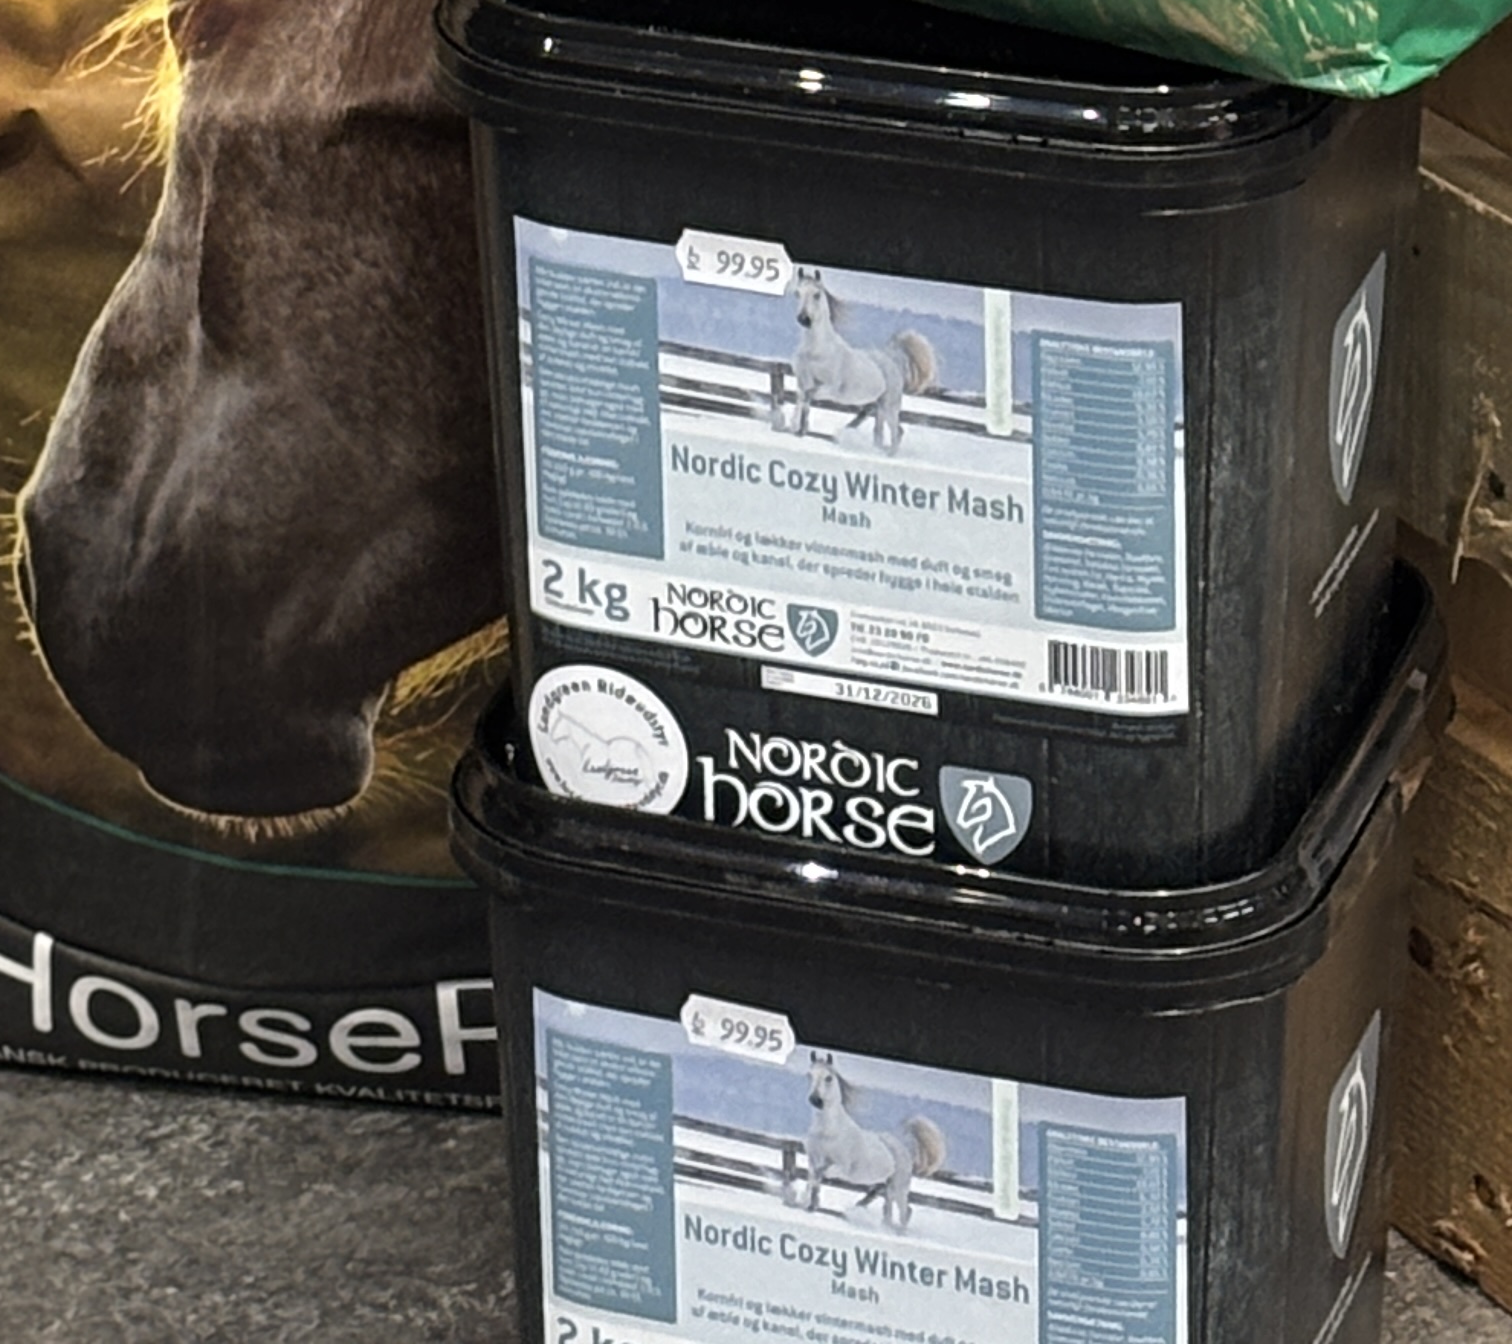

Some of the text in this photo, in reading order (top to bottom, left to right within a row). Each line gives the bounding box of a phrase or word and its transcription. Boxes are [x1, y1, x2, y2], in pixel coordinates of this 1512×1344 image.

[670, 443, 1026, 525] Nordic Cozy Winter Mash
[821, 505, 873, 530] Mash
[734, 530, 754, 548] og
[887, 553, 919, 571] med
[951, 564, 971, 582] og
[541, 558, 631, 623] 2 kg
[724, 727, 920, 797] NORDIC
[719, 1017, 783, 1052] 99.95
[683, 1213, 1031, 1306] Nordic Cozy Winter Mash
[830, 1278, 880, 1305] Mash
